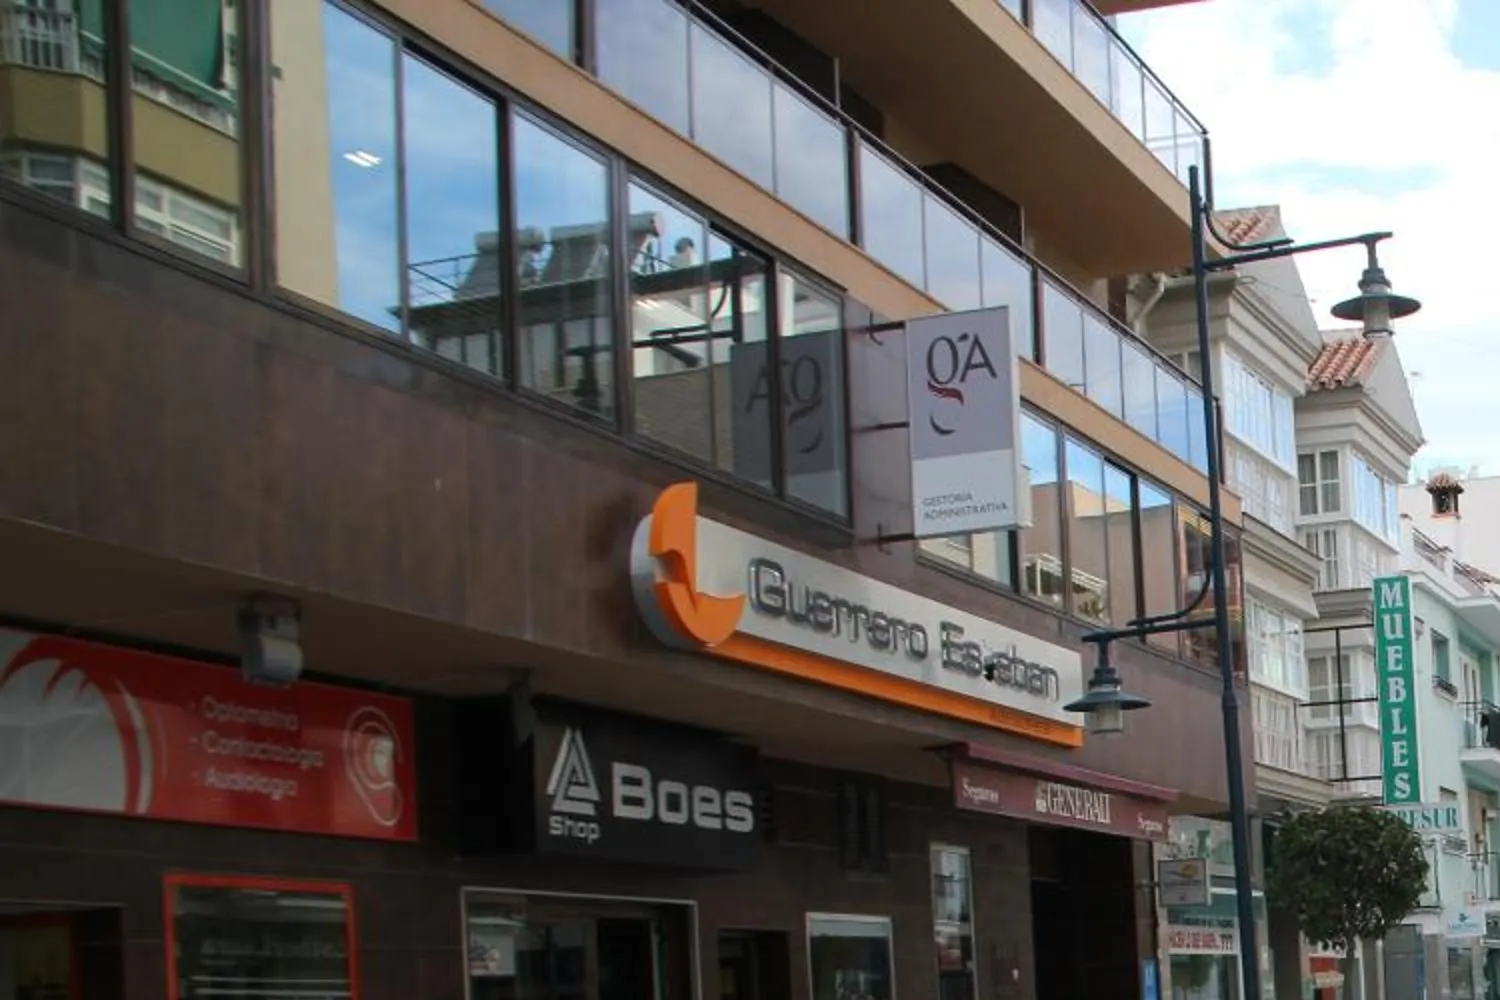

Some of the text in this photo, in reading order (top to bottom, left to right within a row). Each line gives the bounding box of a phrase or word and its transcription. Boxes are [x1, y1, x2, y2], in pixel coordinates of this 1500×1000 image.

[923, 502, 1008, 520] ADMINISTRATIVA
[751, 557, 928, 660] Guerrero
[1378, 581, 1411, 800] MUEBLES
[549, 815, 600, 844] Shop
[611, 761, 754, 832] Boes
